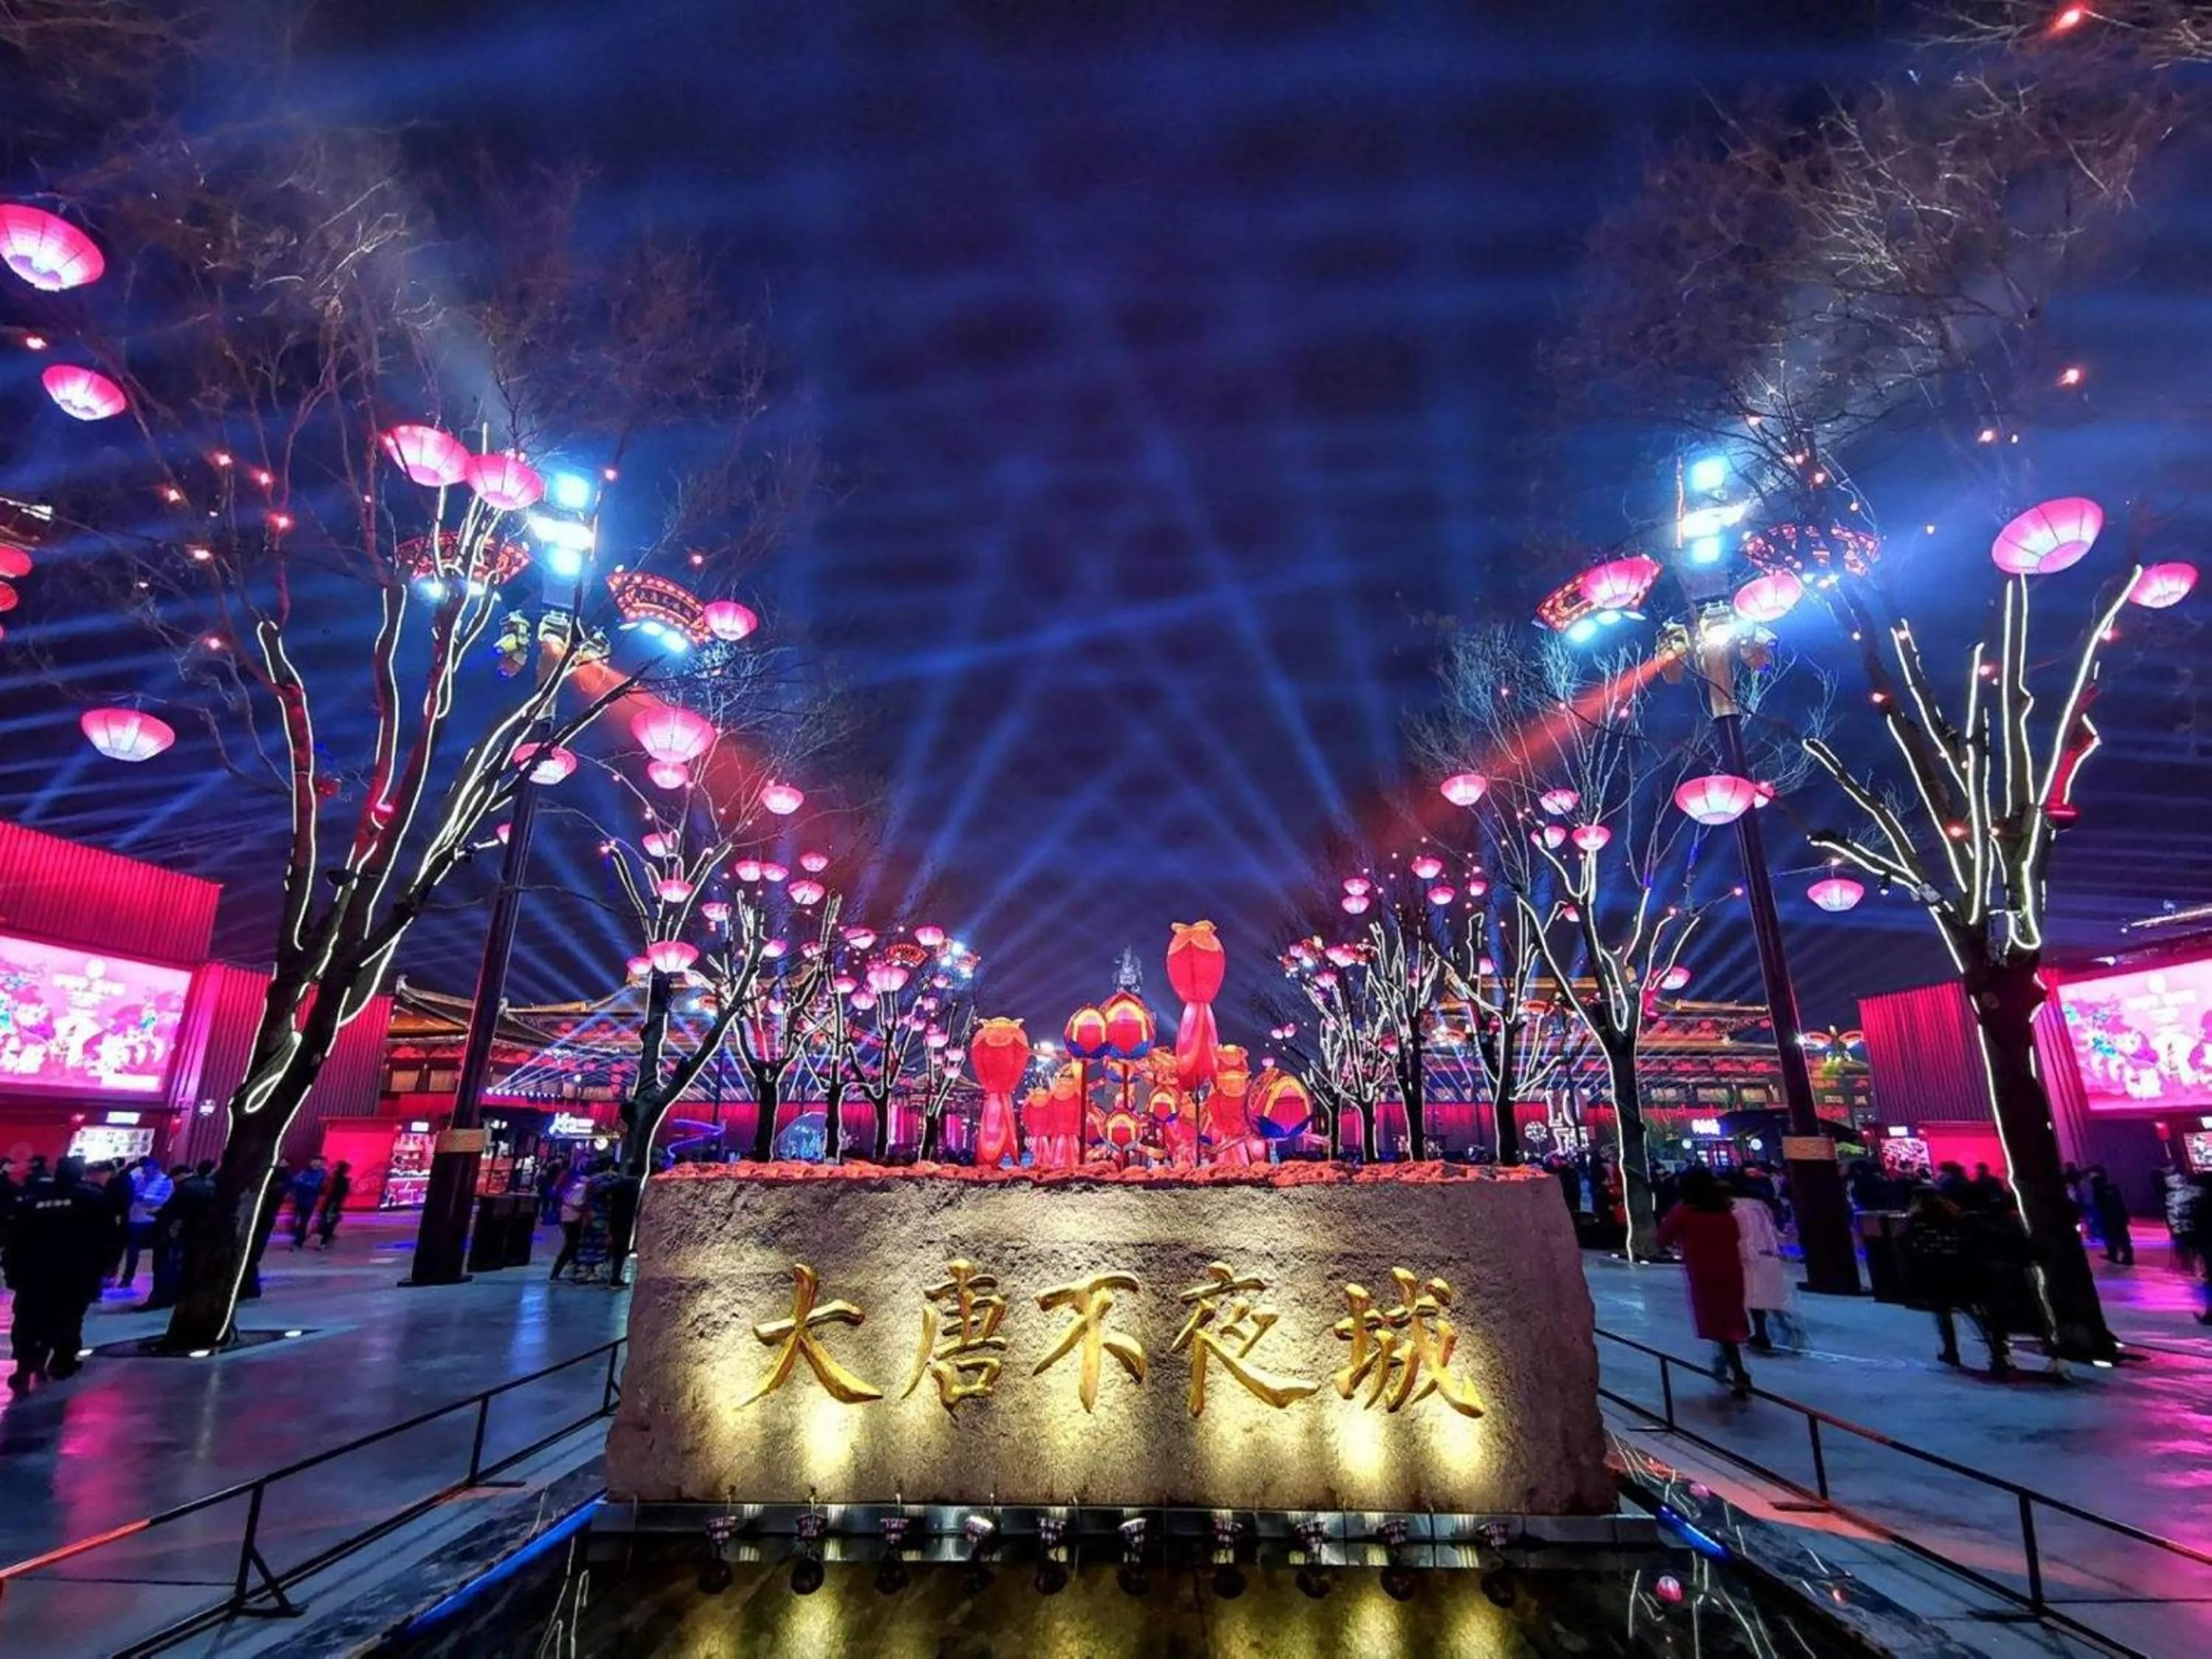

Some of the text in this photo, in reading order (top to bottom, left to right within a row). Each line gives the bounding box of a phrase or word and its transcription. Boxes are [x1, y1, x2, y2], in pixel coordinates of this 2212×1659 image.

[737, 1259, 1484, 1418] 大唐不夜城
